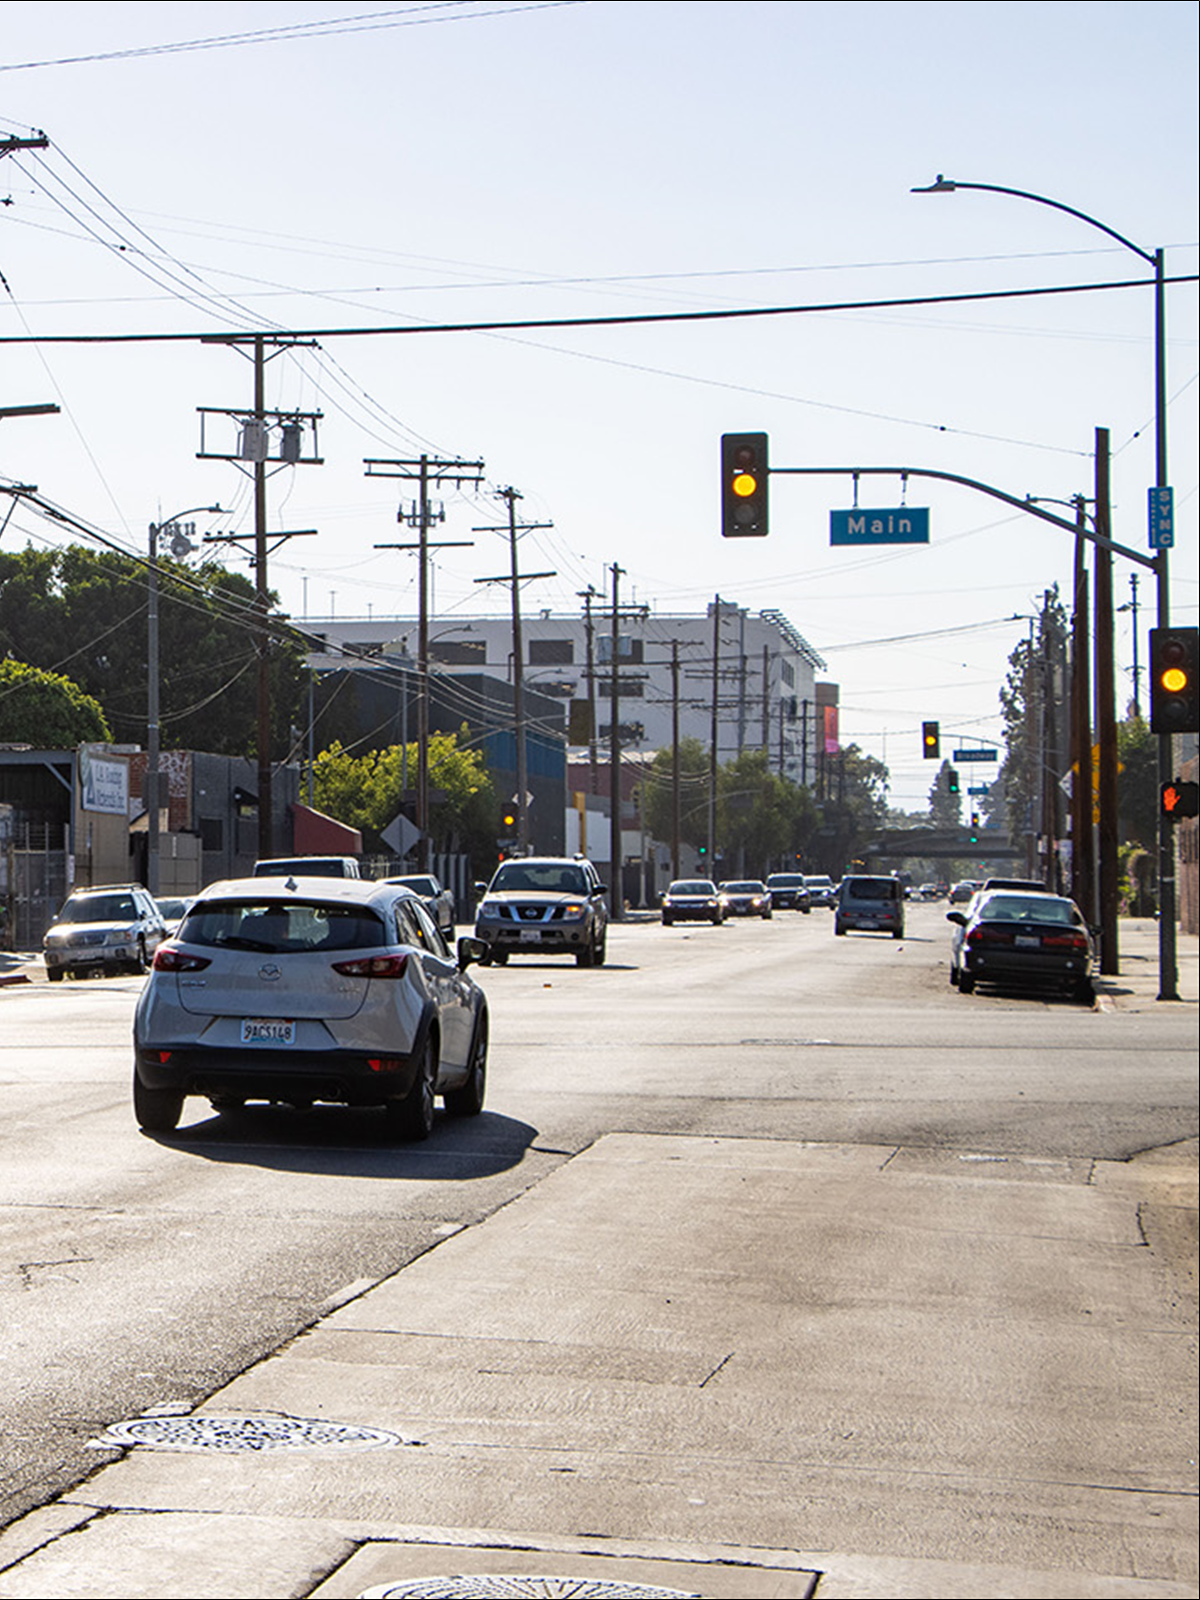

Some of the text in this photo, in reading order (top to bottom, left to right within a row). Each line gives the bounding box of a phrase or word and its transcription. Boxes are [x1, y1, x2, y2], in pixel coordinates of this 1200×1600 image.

[848, 515, 911, 534] Main
[1159, 491, 1172, 545] SYNC
[244, 1025, 292, 1040] 9ACS148
